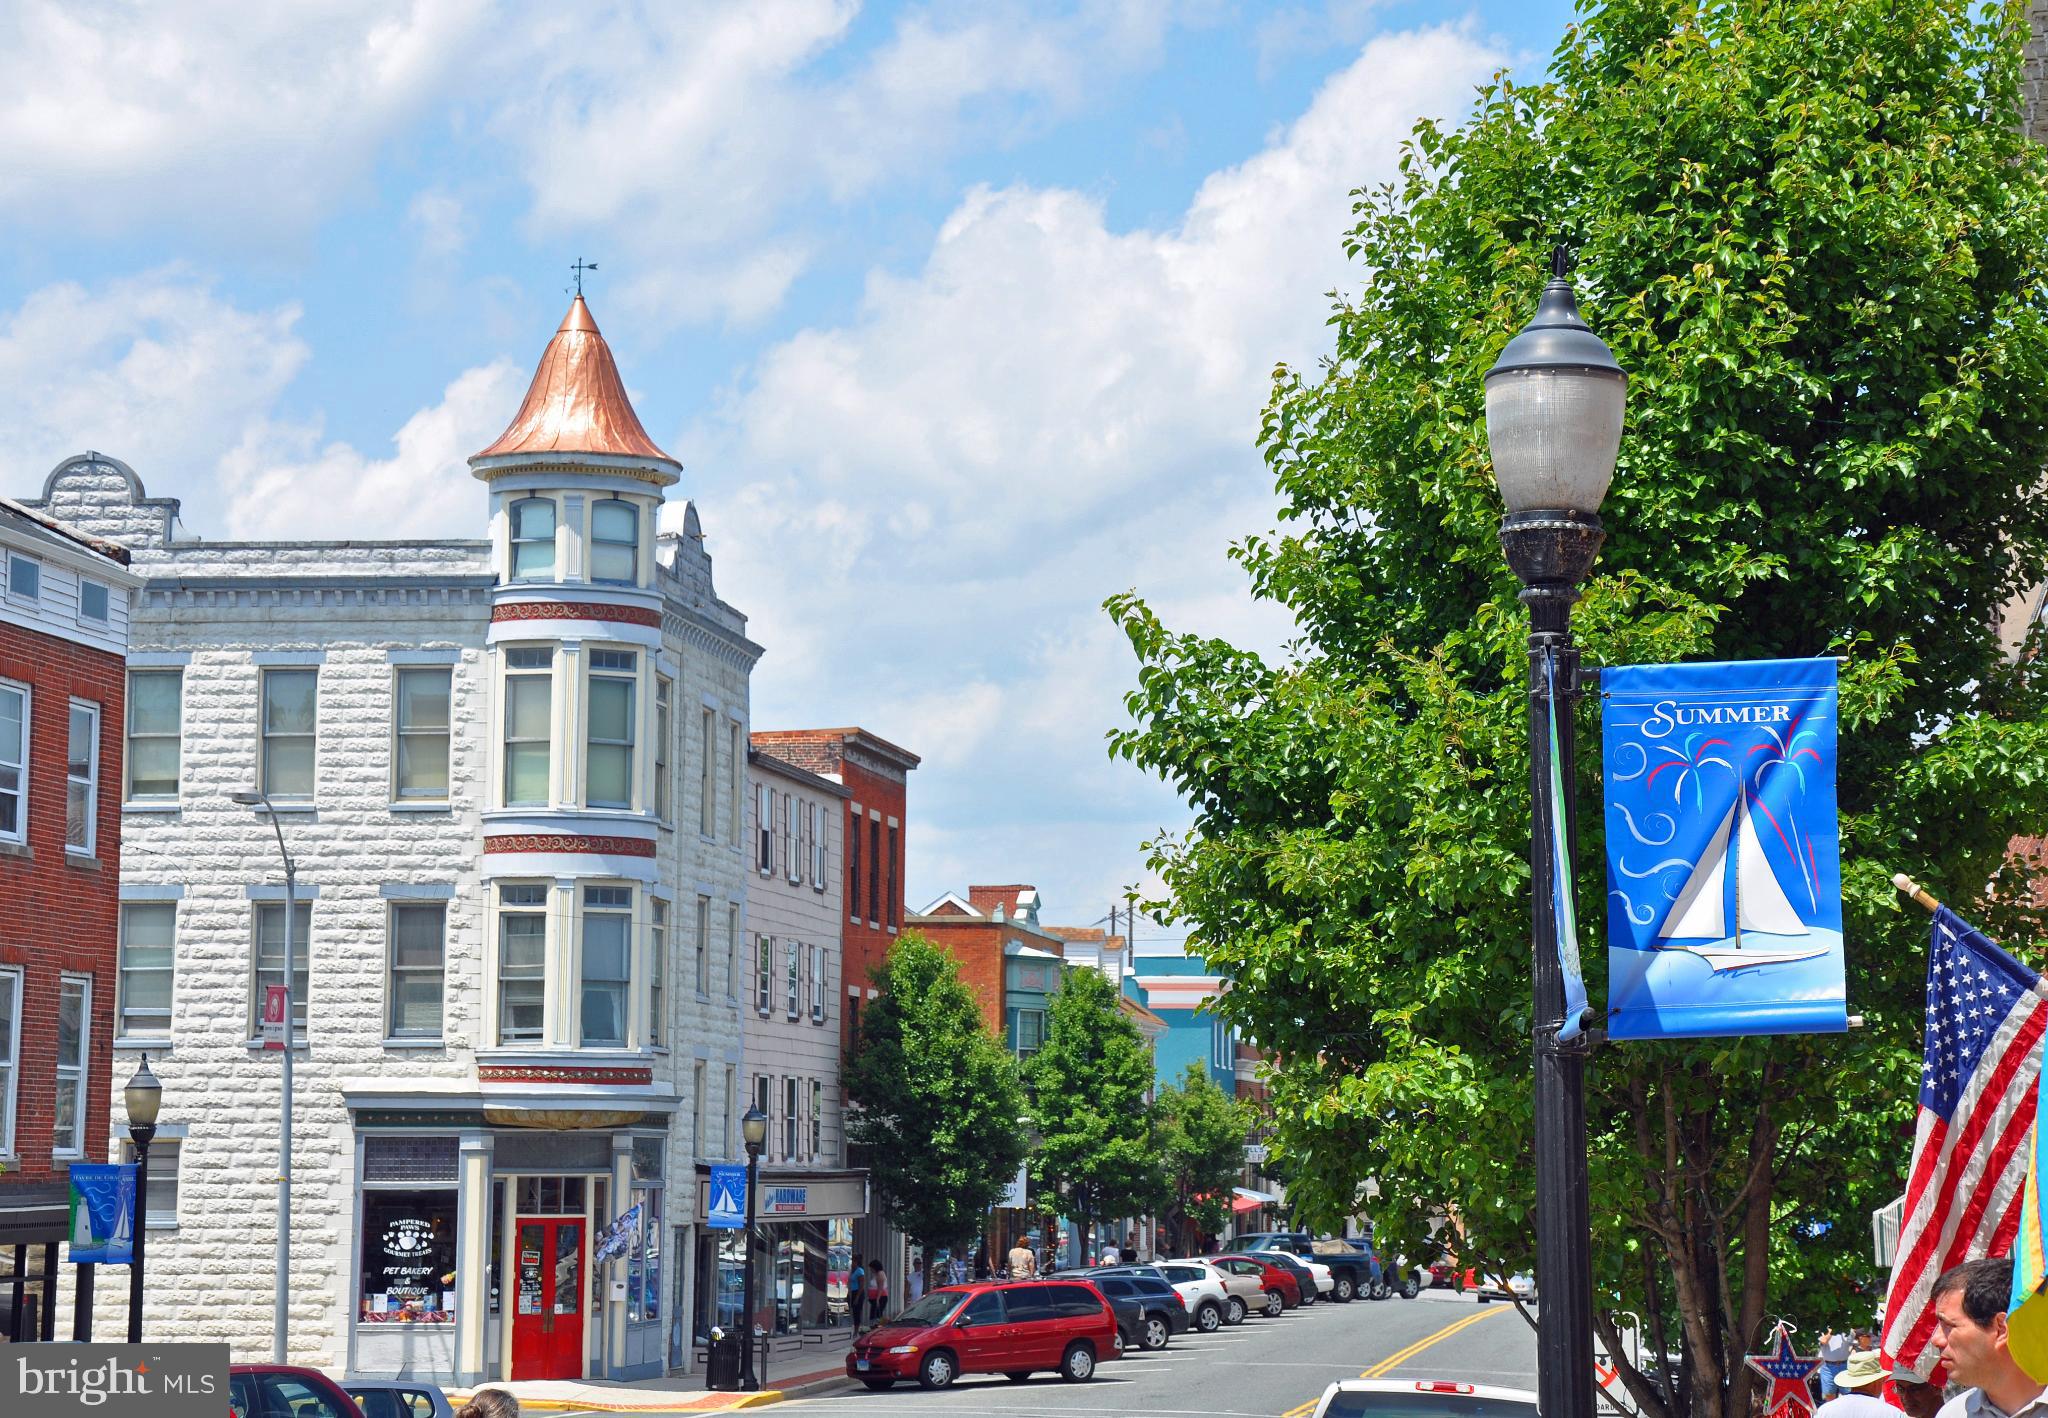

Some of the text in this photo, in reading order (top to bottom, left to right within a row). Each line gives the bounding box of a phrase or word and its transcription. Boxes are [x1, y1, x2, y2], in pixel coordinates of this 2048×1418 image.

[1641, 700, 1791, 738] SUMMER
[775, 1188, 806, 1204] HARDWARE
[389, 1219, 431, 1228] PAMPERED
[383, 1247, 433, 1258] GOURMET TREATS
[383, 1266, 434, 1275] PET BAKERY
[404, 1277, 411, 1285] &
[386, 1286, 429, 1295] BOUTIQUE
